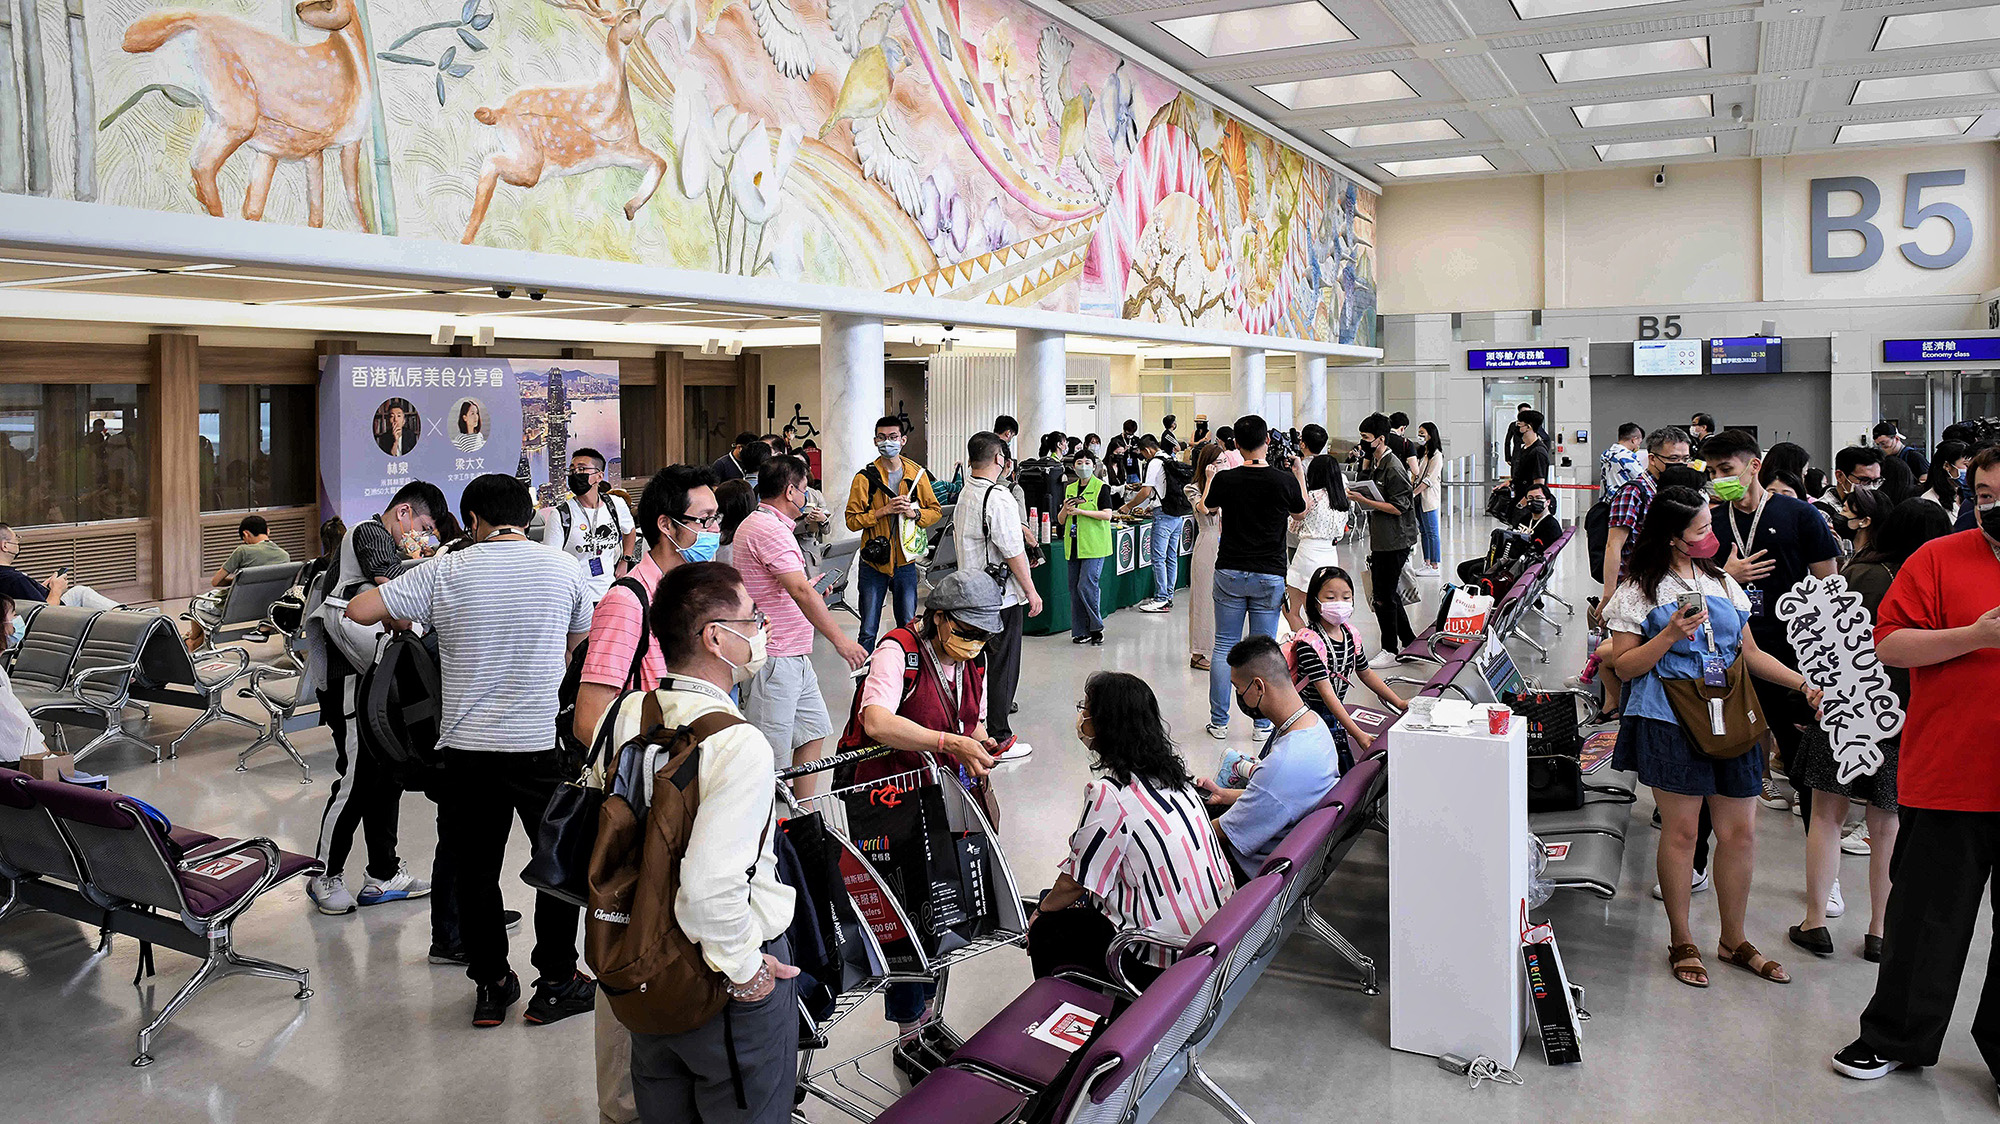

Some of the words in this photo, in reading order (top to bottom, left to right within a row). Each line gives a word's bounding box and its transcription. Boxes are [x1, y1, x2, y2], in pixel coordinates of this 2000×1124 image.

[1811, 169, 1973, 273] B5
[1639, 315, 1682, 340] B5
[1922, 340, 1956, 351] 經濟艙
[1486, 350, 1544, 361] 頭等艙/商務艙
[1922, 351, 1953, 359] Economy
[352, 366, 504, 388] 香港私房美食分享會
[455, 457, 485, 471] 梁大文
[583, 543, 617, 552] Taiwa
[1444, 618, 1472, 632] duty
[1822, 578, 1900, 732] #A330neo
[594, 908, 631, 924] Glenfiddich
[834, 921, 846, 945] Airport
[884, 921, 898, 932] 601
[1528, 954, 1548, 999] everrich
